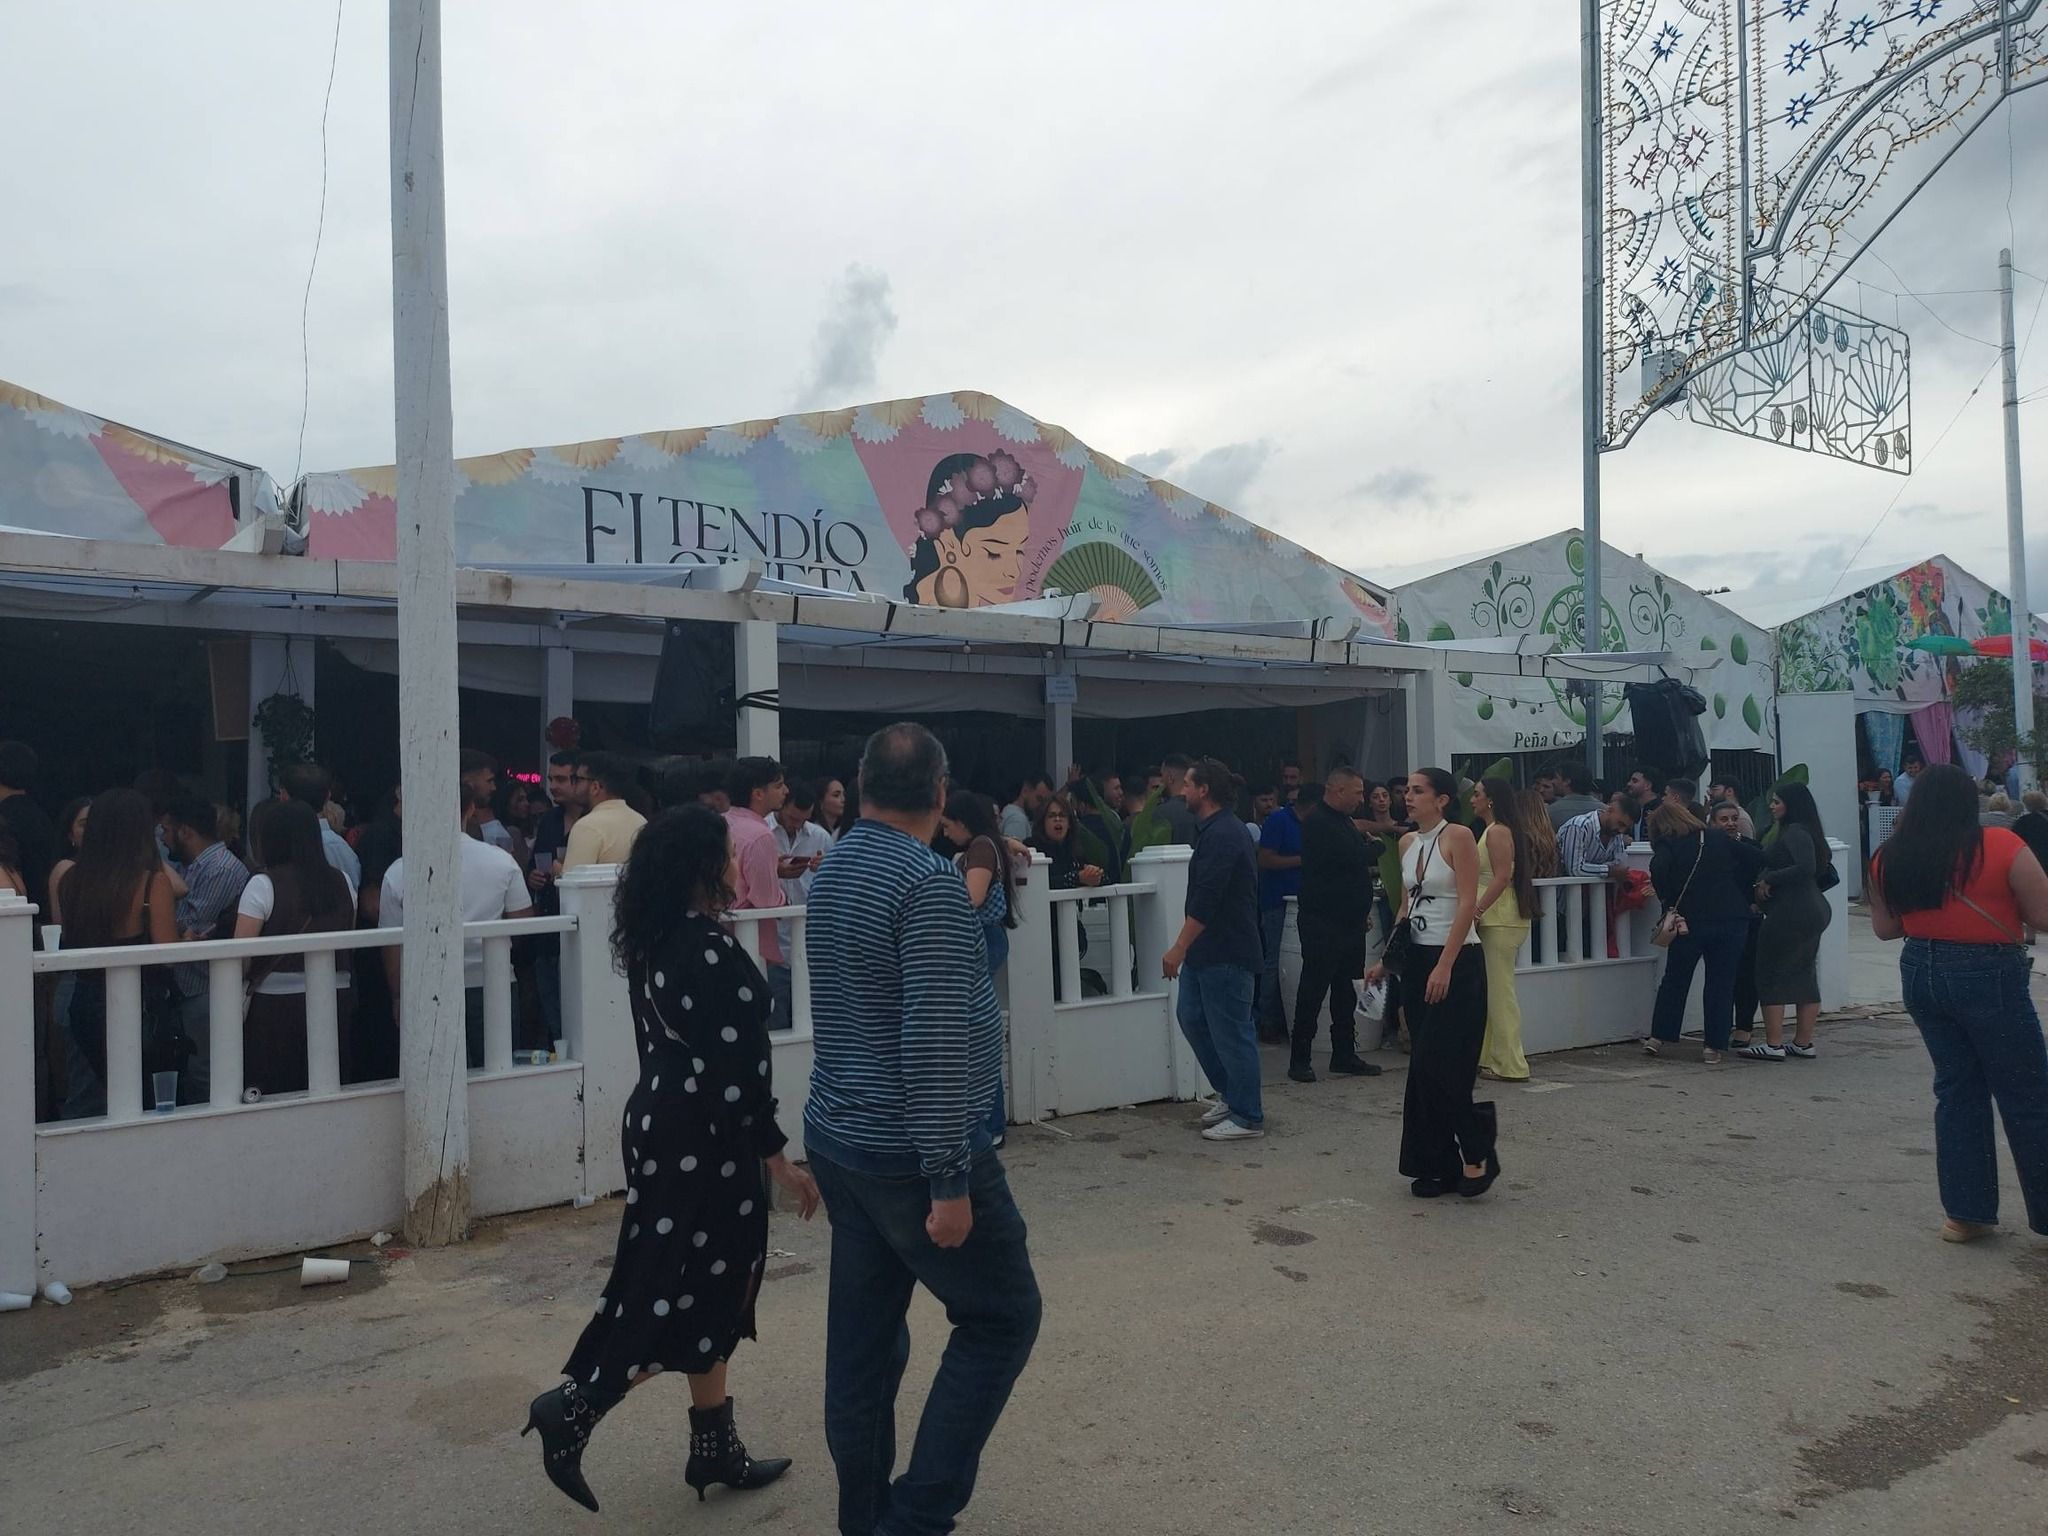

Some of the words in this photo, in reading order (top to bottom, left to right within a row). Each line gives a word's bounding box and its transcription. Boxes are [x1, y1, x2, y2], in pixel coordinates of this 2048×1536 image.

[657, 496, 869, 567] TENDÍO
[1025, 536, 1058, 593] podemos
[1057, 520, 1082, 540] huir
[1088, 516, 1103, 530] de
[1106, 520, 1117, 535] lo
[1120, 530, 1140, 549] que
[1143, 550, 1168, 592] somos
[1513, 731, 1548, 748] Peña
